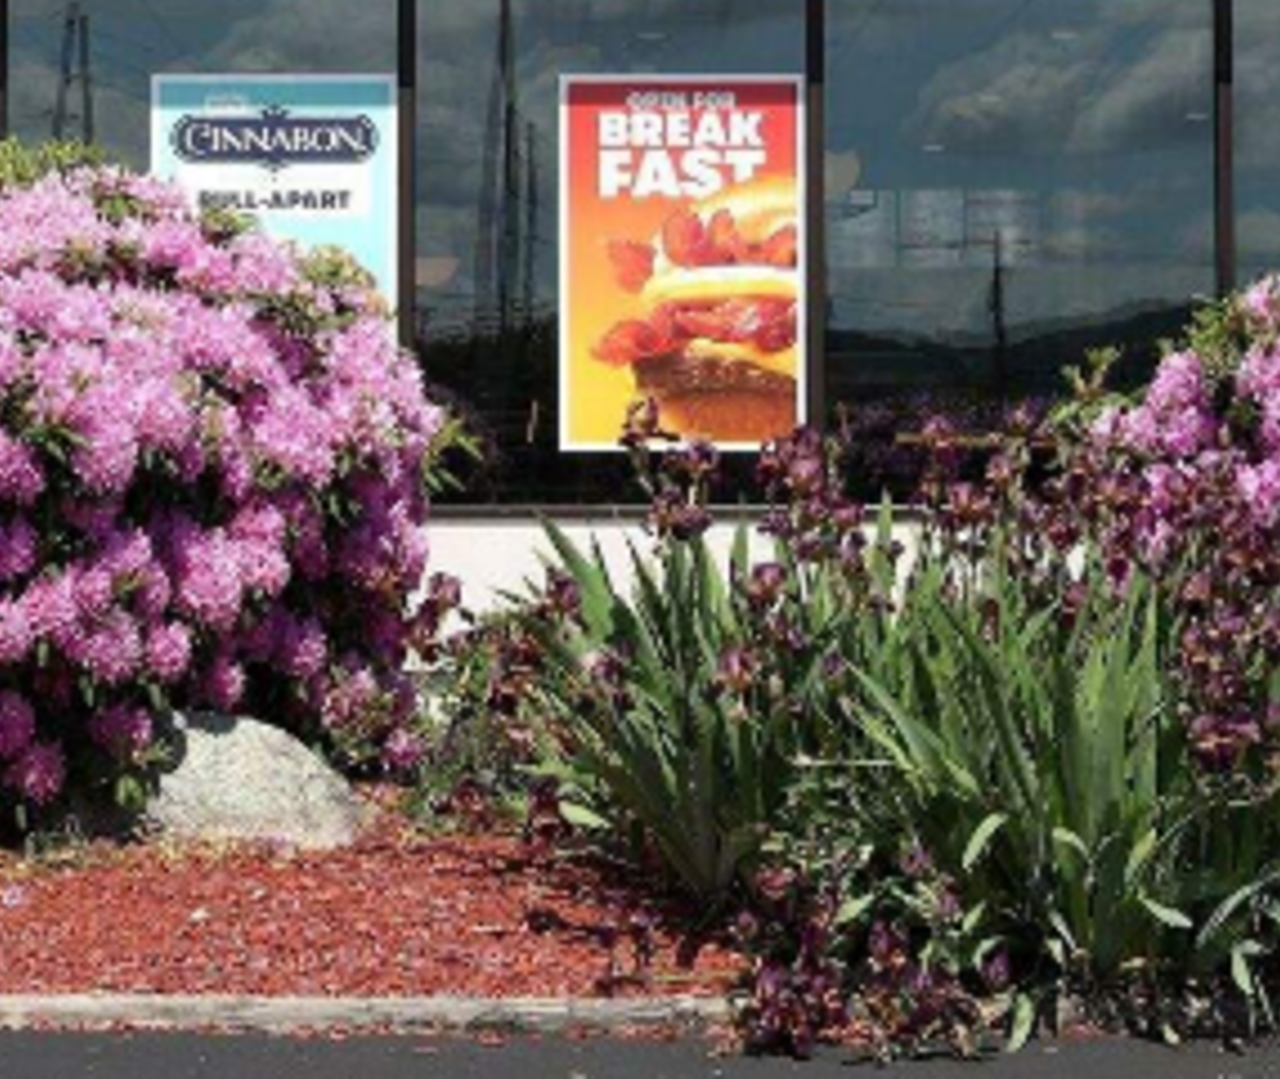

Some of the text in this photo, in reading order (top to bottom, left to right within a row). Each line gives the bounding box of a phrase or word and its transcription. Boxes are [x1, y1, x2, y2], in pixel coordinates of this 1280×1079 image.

[185, 124, 367, 156] CINNABON
[599, 113, 765, 147] BREAK
[599, 150, 767, 200] FAST
